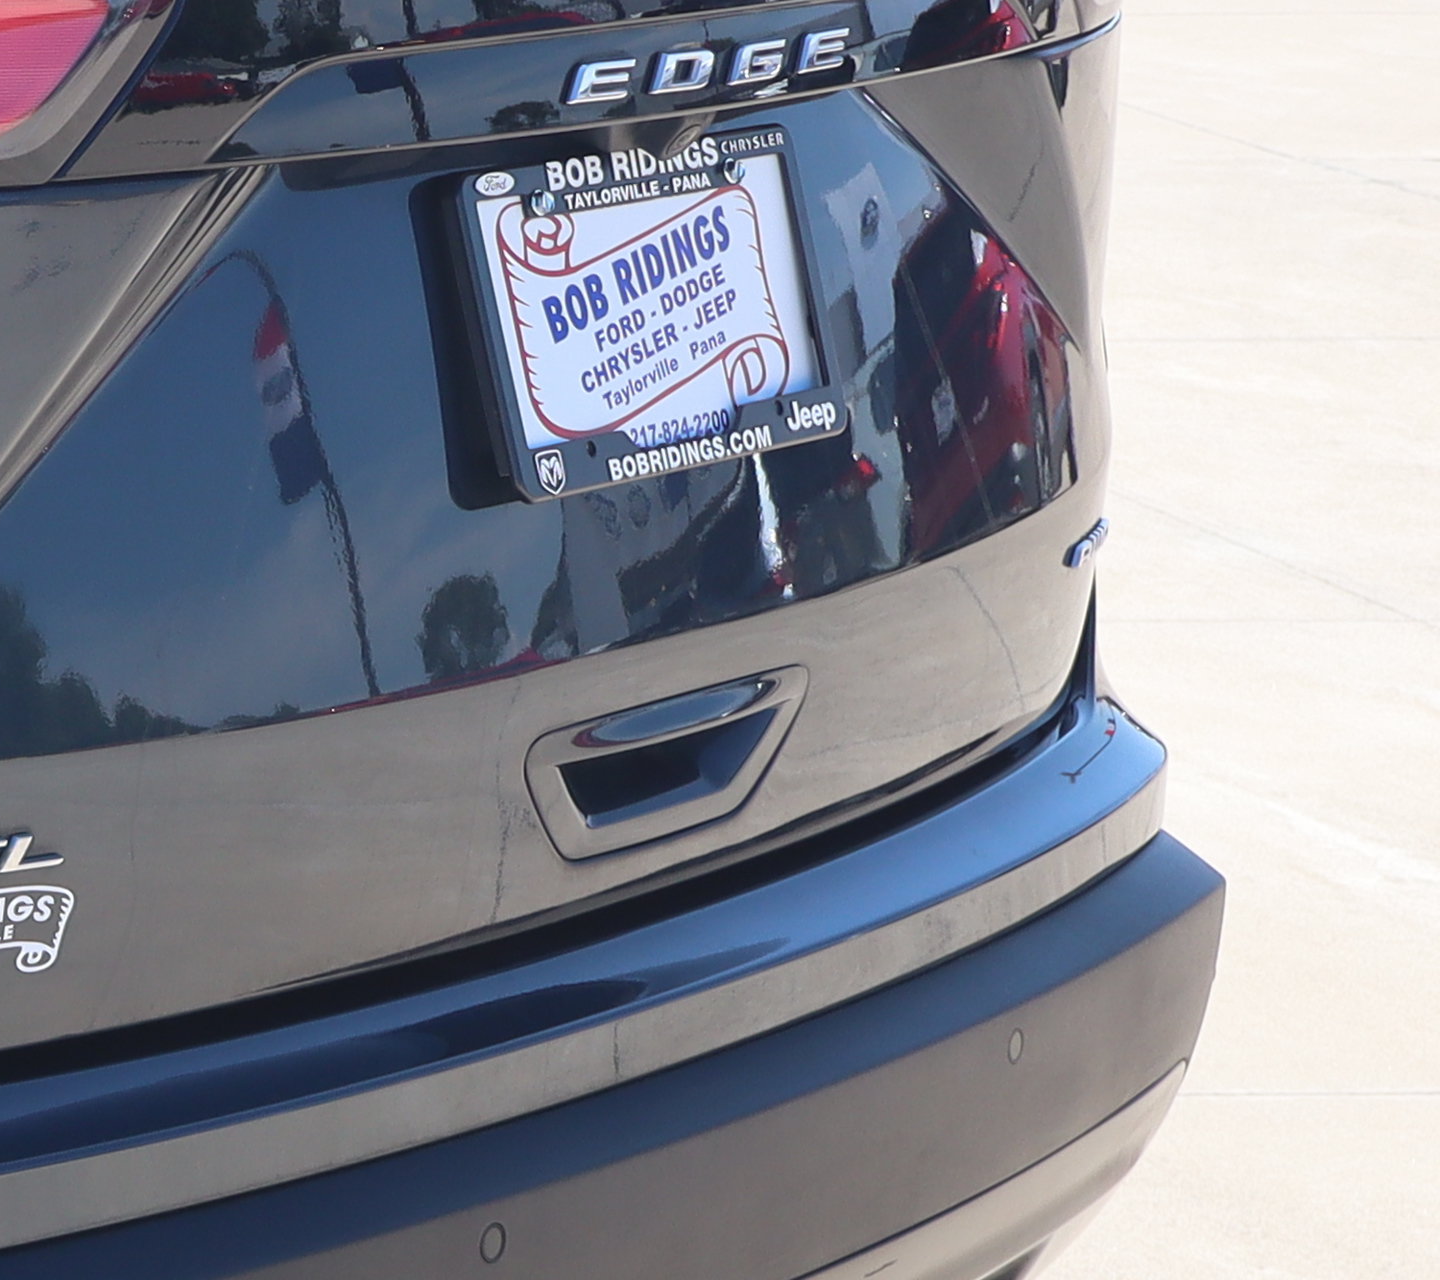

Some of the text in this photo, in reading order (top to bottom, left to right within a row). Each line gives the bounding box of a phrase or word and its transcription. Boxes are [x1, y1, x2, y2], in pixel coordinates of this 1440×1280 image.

[565, 27, 851, 106] EDGE
[545, 154, 605, 193] BOB
[720, 131, 784, 155] CHRYSLER
[563, 179, 660, 210] TAYLORVILLE
[672, 172, 712, 193] PANA
[541, 205, 731, 344] BOB RIDINGS
[594, 307, 646, 352] FORD
[661, 263, 726, 317] DODGE
[580, 322, 679, 393] CHRYSLER
[693, 287, 738, 333] JEEP
[602, 329, 727, 411] Taylorville Pana
[787, 400, 837, 432] Jeep
[608, 425, 772, 482] BOBRIDINGS.COM
